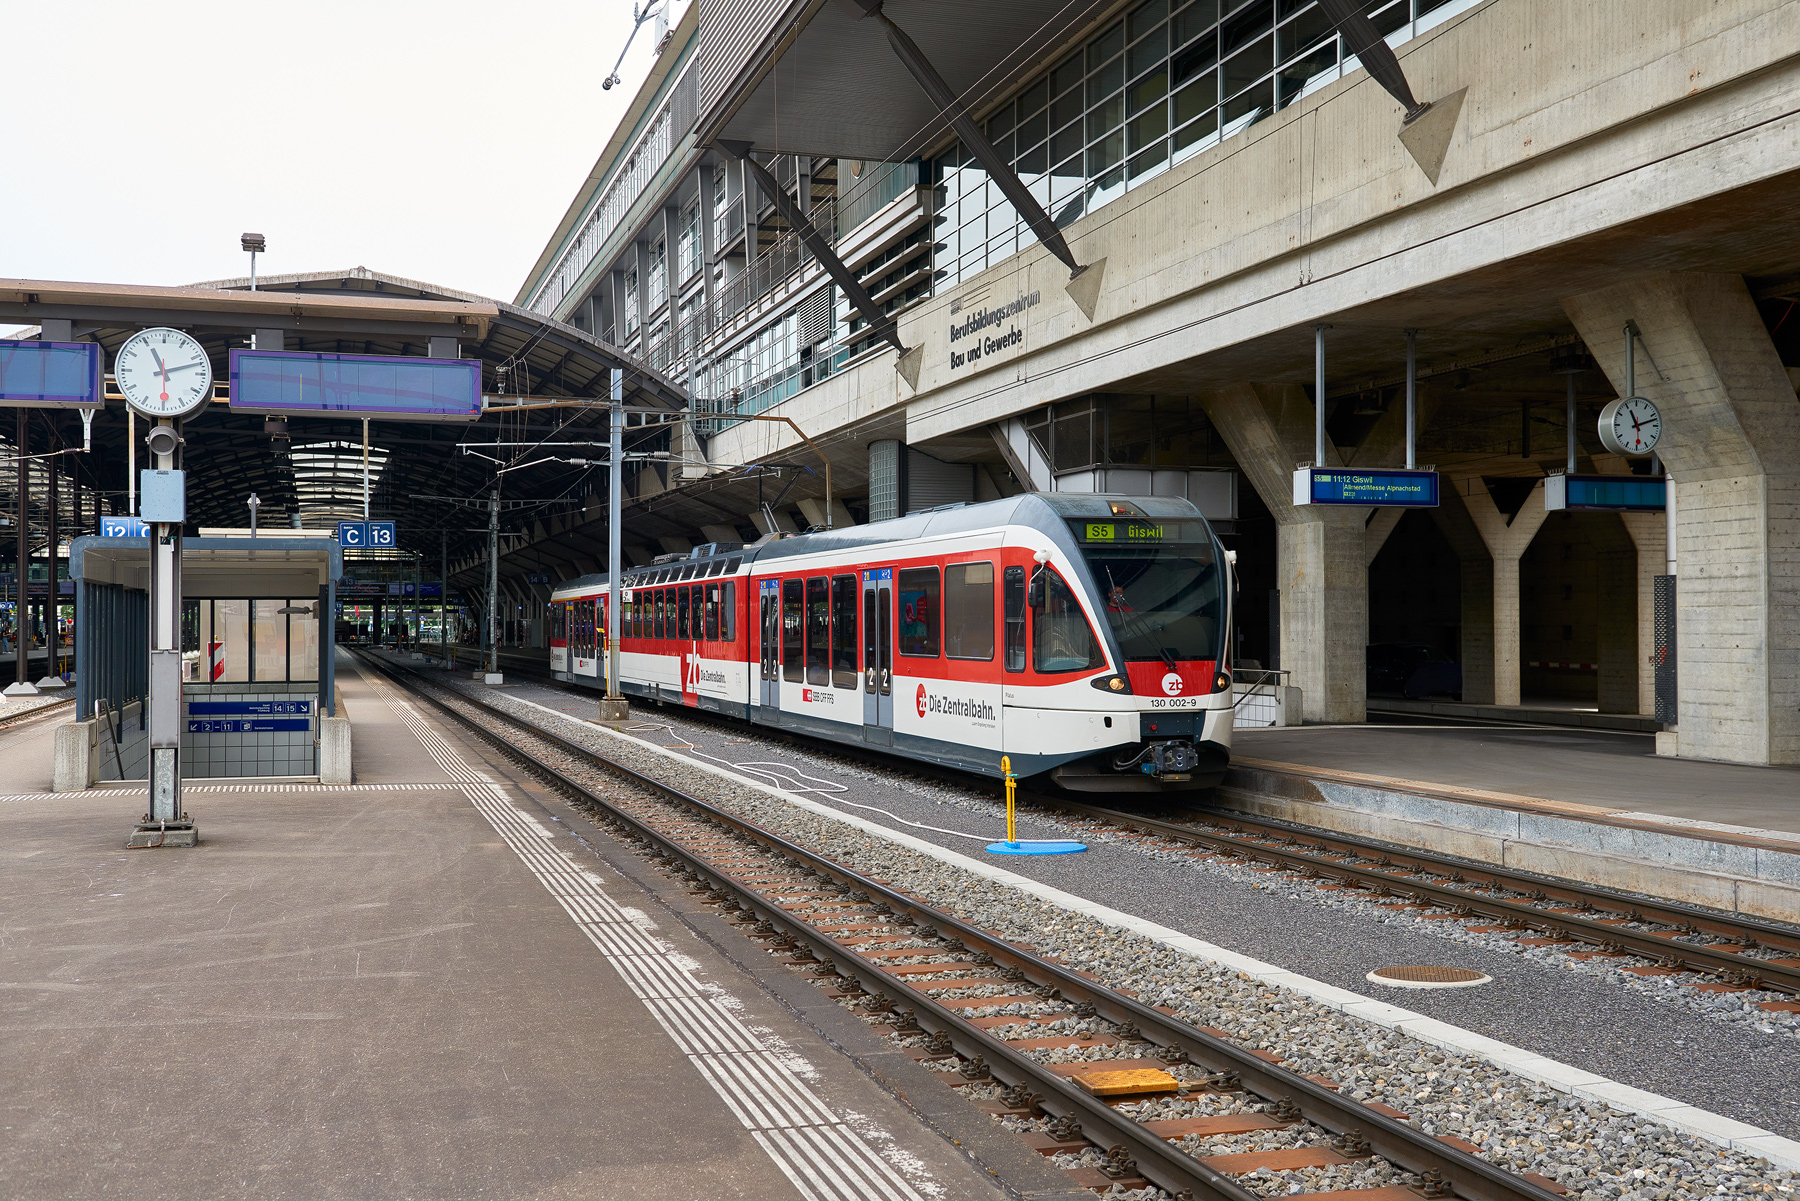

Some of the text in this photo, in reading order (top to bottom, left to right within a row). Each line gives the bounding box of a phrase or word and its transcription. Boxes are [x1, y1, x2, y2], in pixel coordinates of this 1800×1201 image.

[950, 291, 1040, 343] Berufsbildungszentrum
[950, 324, 1022, 370] Bau und Gewerbe
[1352, 475, 1372, 483] Giswil
[106, 526, 126, 537] 12
[346, 530, 390, 543] C 13
[1091, 525, 1163, 538] S5 Giswil
[763, 658, 768, 674] 2
[772, 659, 777, 675] 2
[868, 667, 874, 685] 2
[882, 668, 888, 687] 2
[1168, 679, 1184, 690] zb
[929, 694, 996, 721] Die Zentralbahn.
[1150, 698, 1197, 707] 130 002-9
